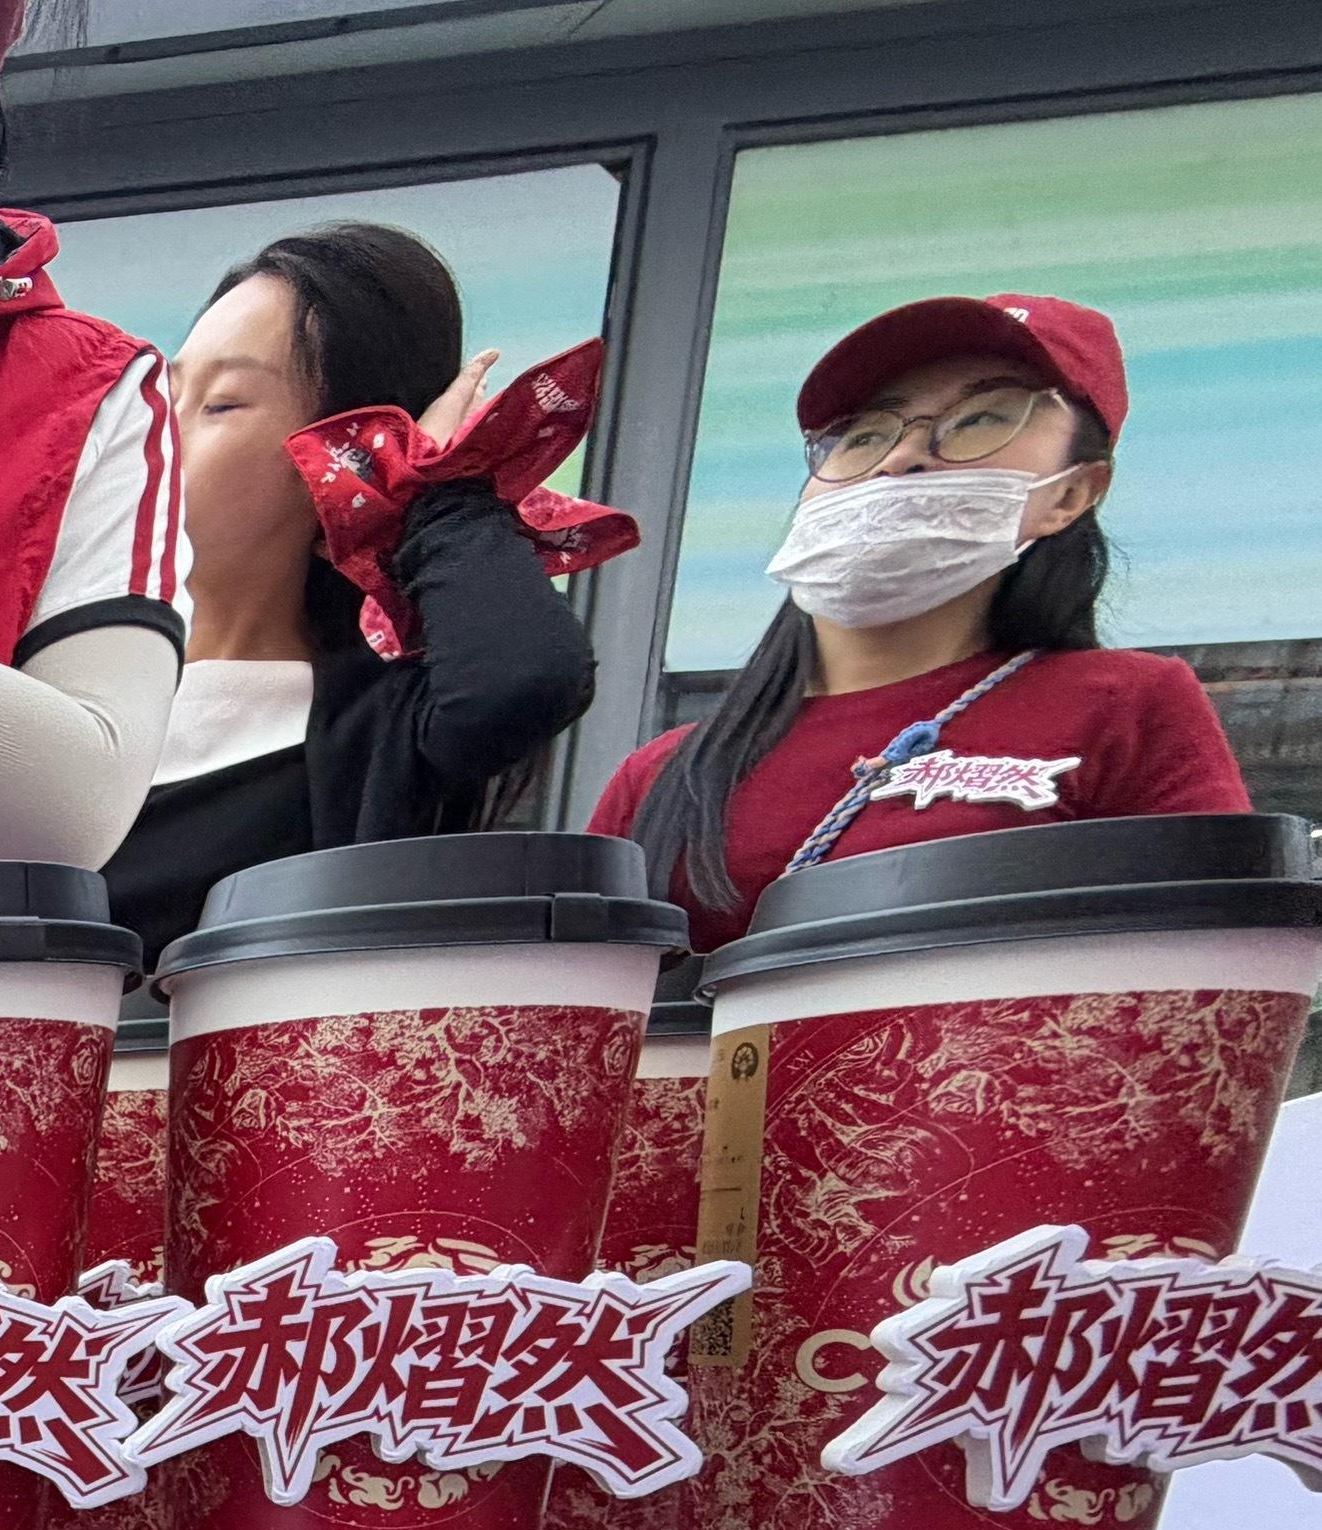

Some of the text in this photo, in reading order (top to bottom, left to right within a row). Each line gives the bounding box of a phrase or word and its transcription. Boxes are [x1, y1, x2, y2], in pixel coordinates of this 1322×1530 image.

[897, 756, 1043, 799] 郝熠然
[202, 1277, 665, 1470] 郝熠然
